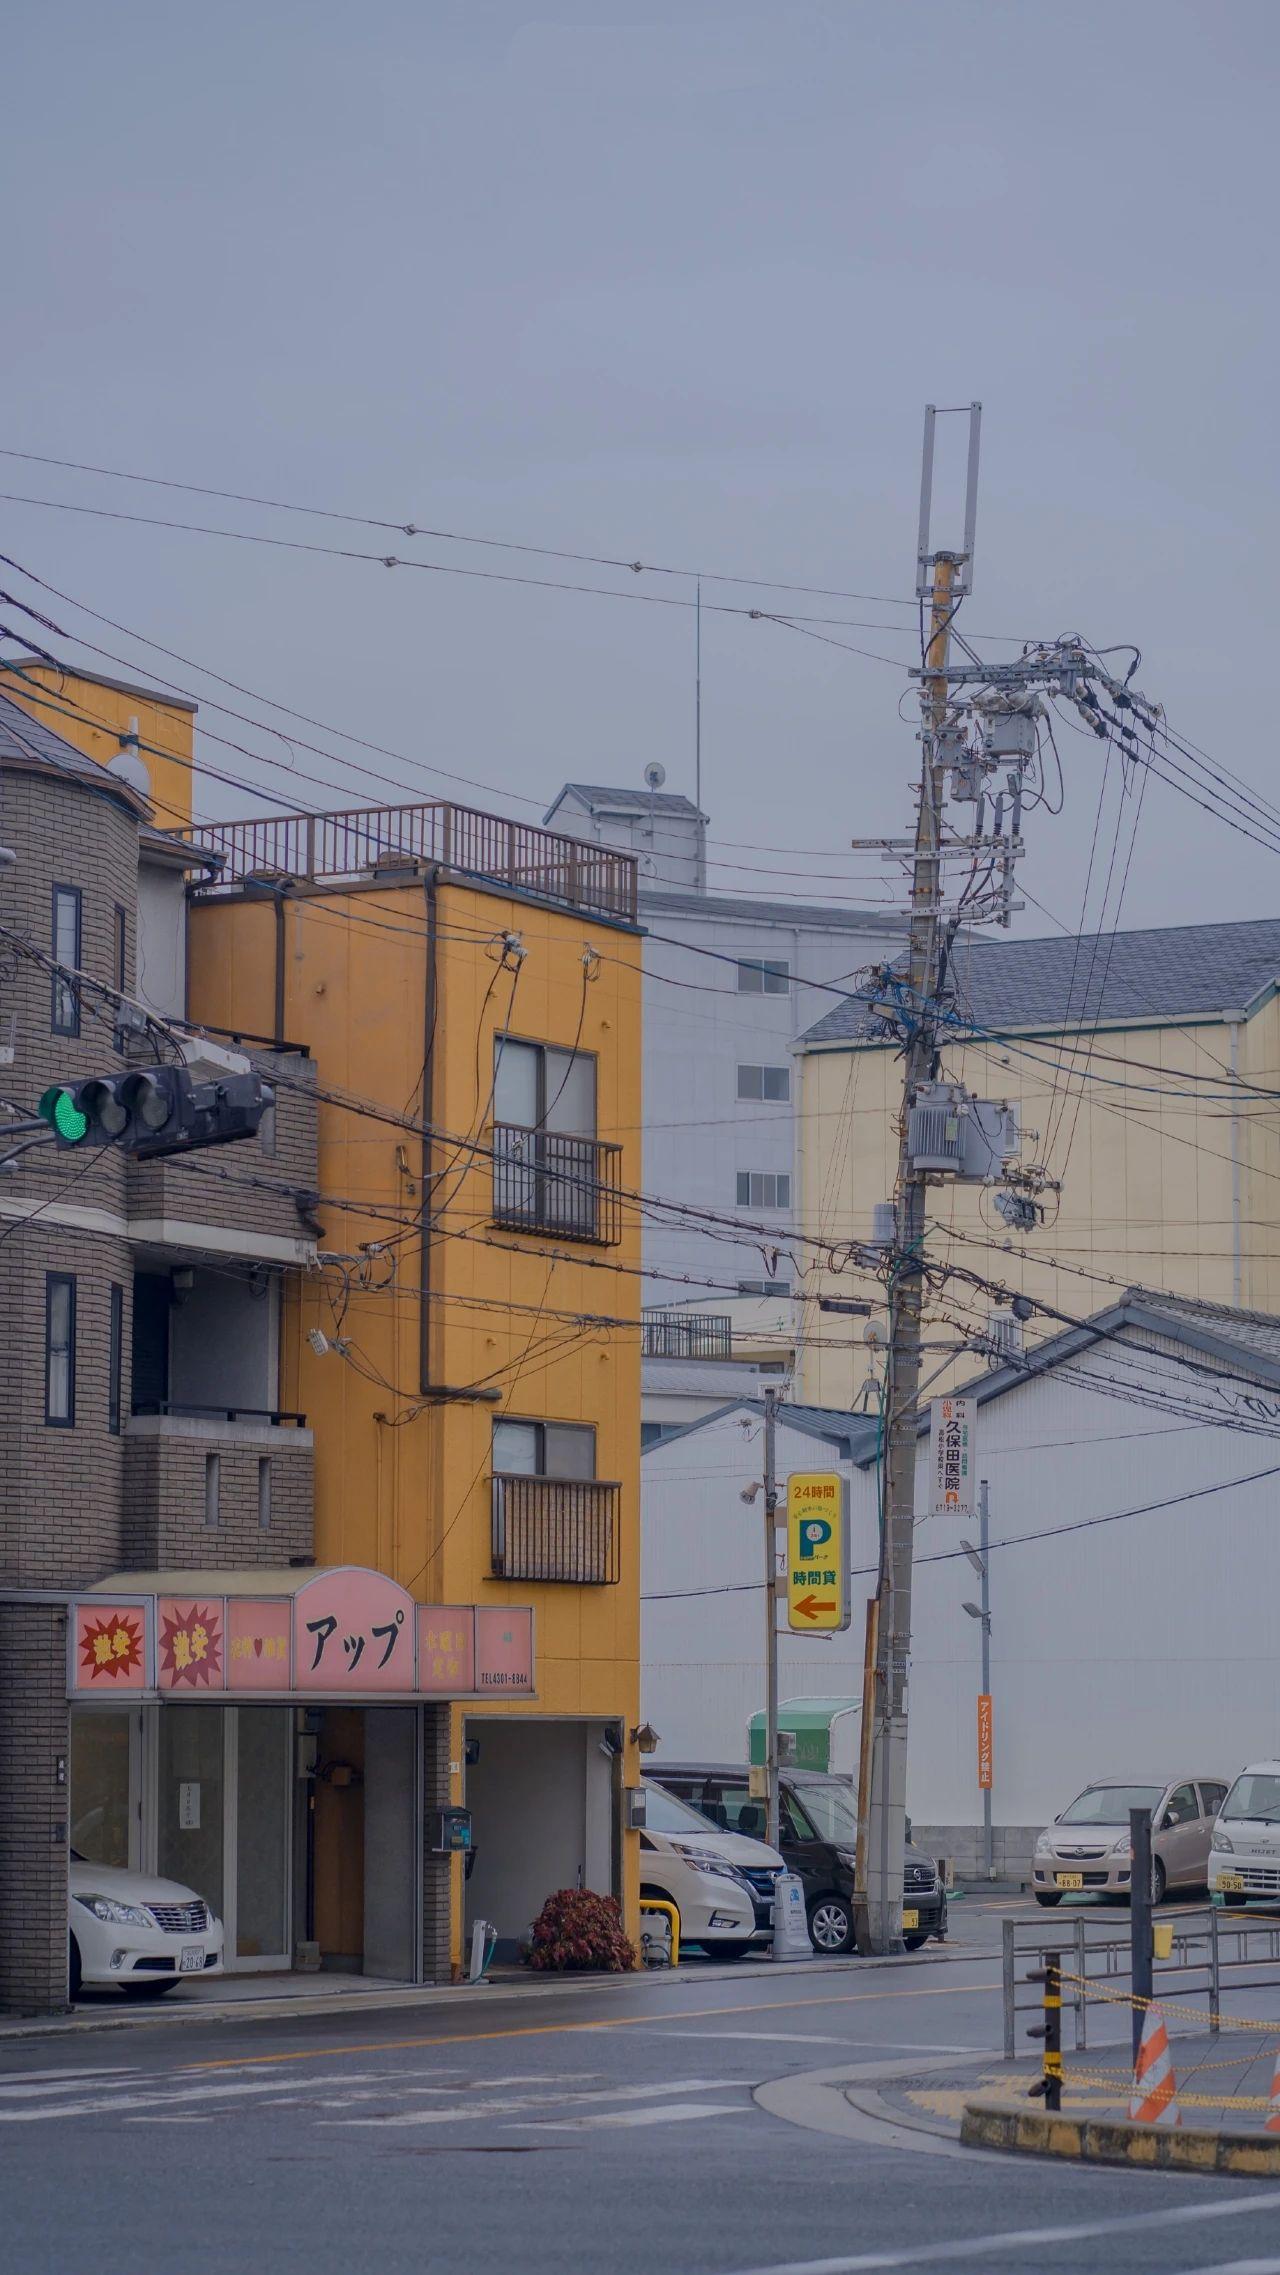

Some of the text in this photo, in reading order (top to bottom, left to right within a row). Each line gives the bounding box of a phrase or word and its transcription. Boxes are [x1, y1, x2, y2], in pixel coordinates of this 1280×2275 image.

[956, 1400, 966, 1419] 内科
[945, 1420, 961, 1490] 久保田医院
[794, 1485, 835, 1499] 24時間
[793, 1570, 837, 1585] 時間貸
[306, 1609, 404, 1672] アップ
